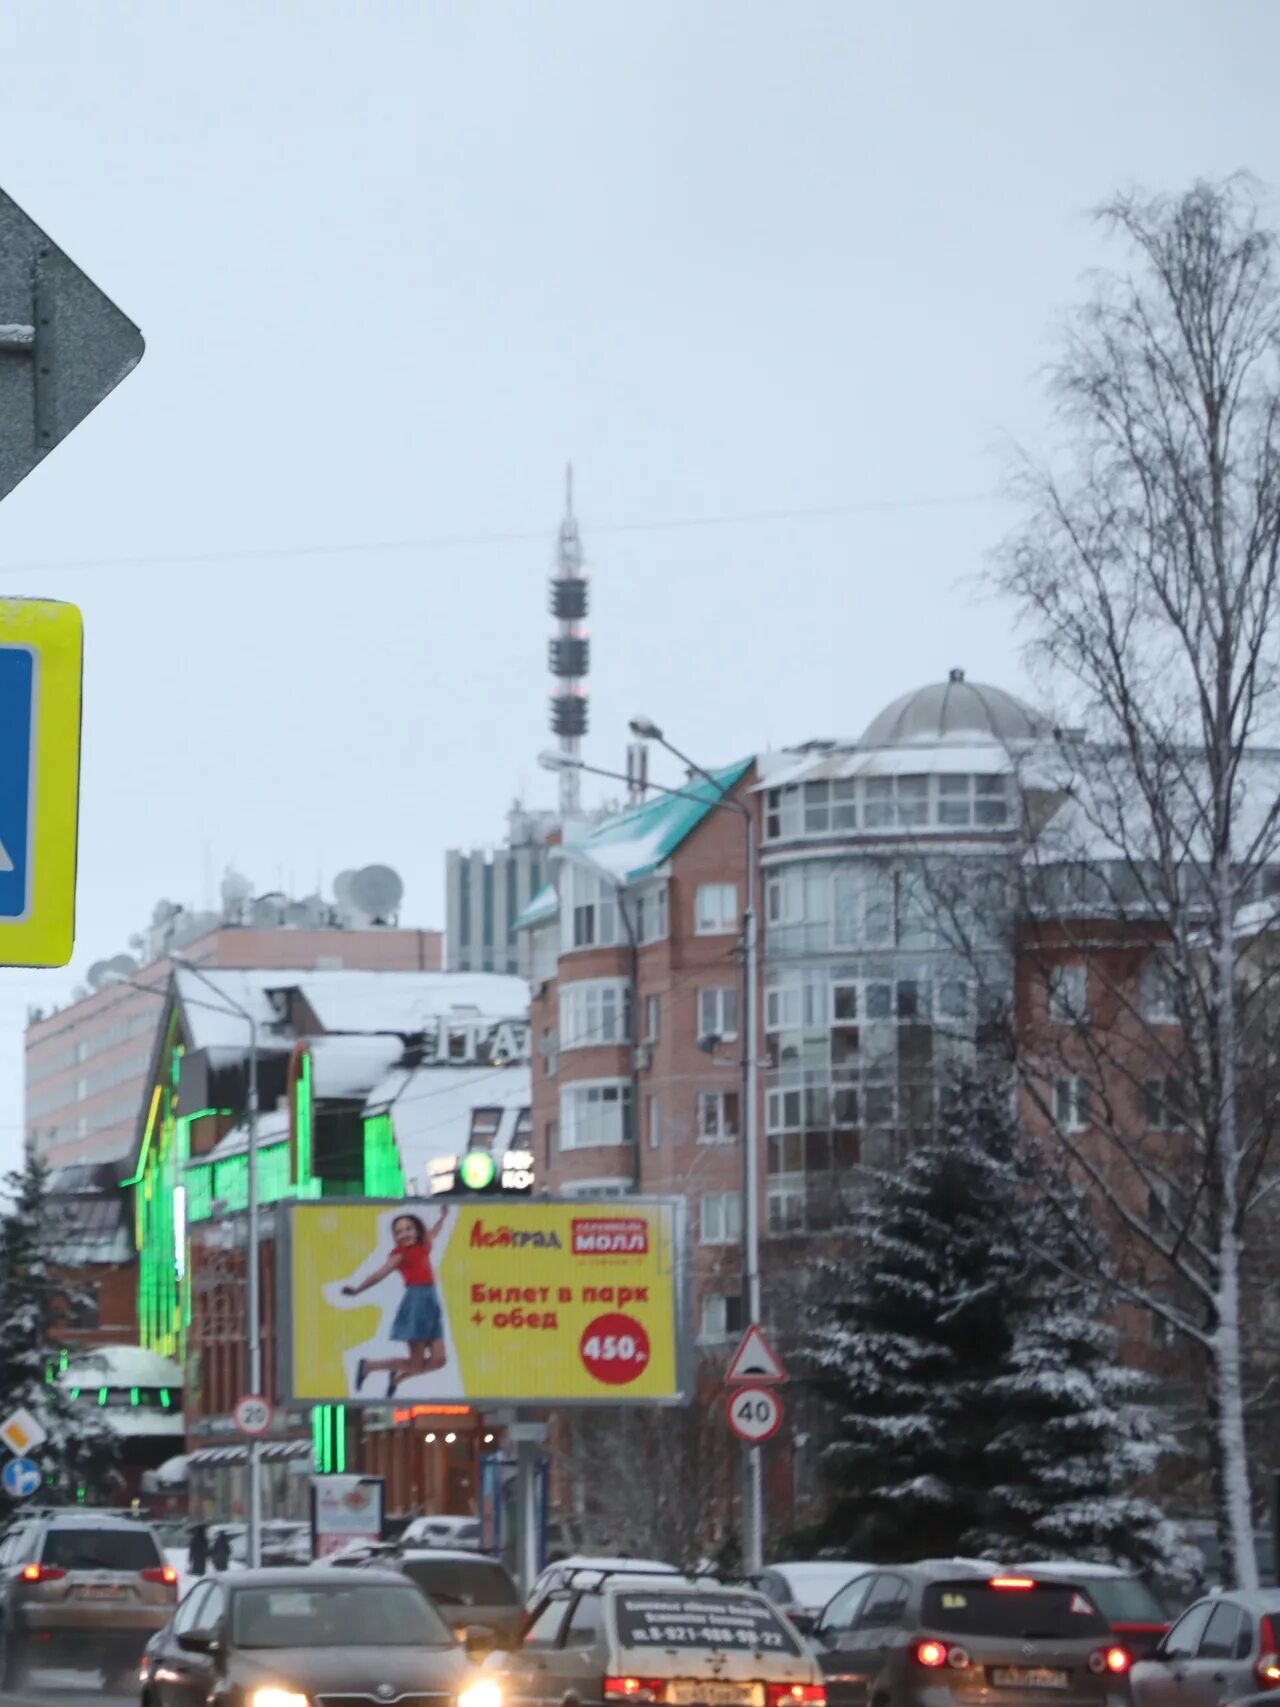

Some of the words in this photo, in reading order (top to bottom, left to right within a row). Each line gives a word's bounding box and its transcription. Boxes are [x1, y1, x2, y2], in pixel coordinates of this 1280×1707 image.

[471, 1283, 550, 1304] Билет
[558, 1286, 572, 1303] в
[582, 1286, 648, 1309] парк
[493, 1308, 558, 1330] обед
[738, 1401, 770, 1423] 40
